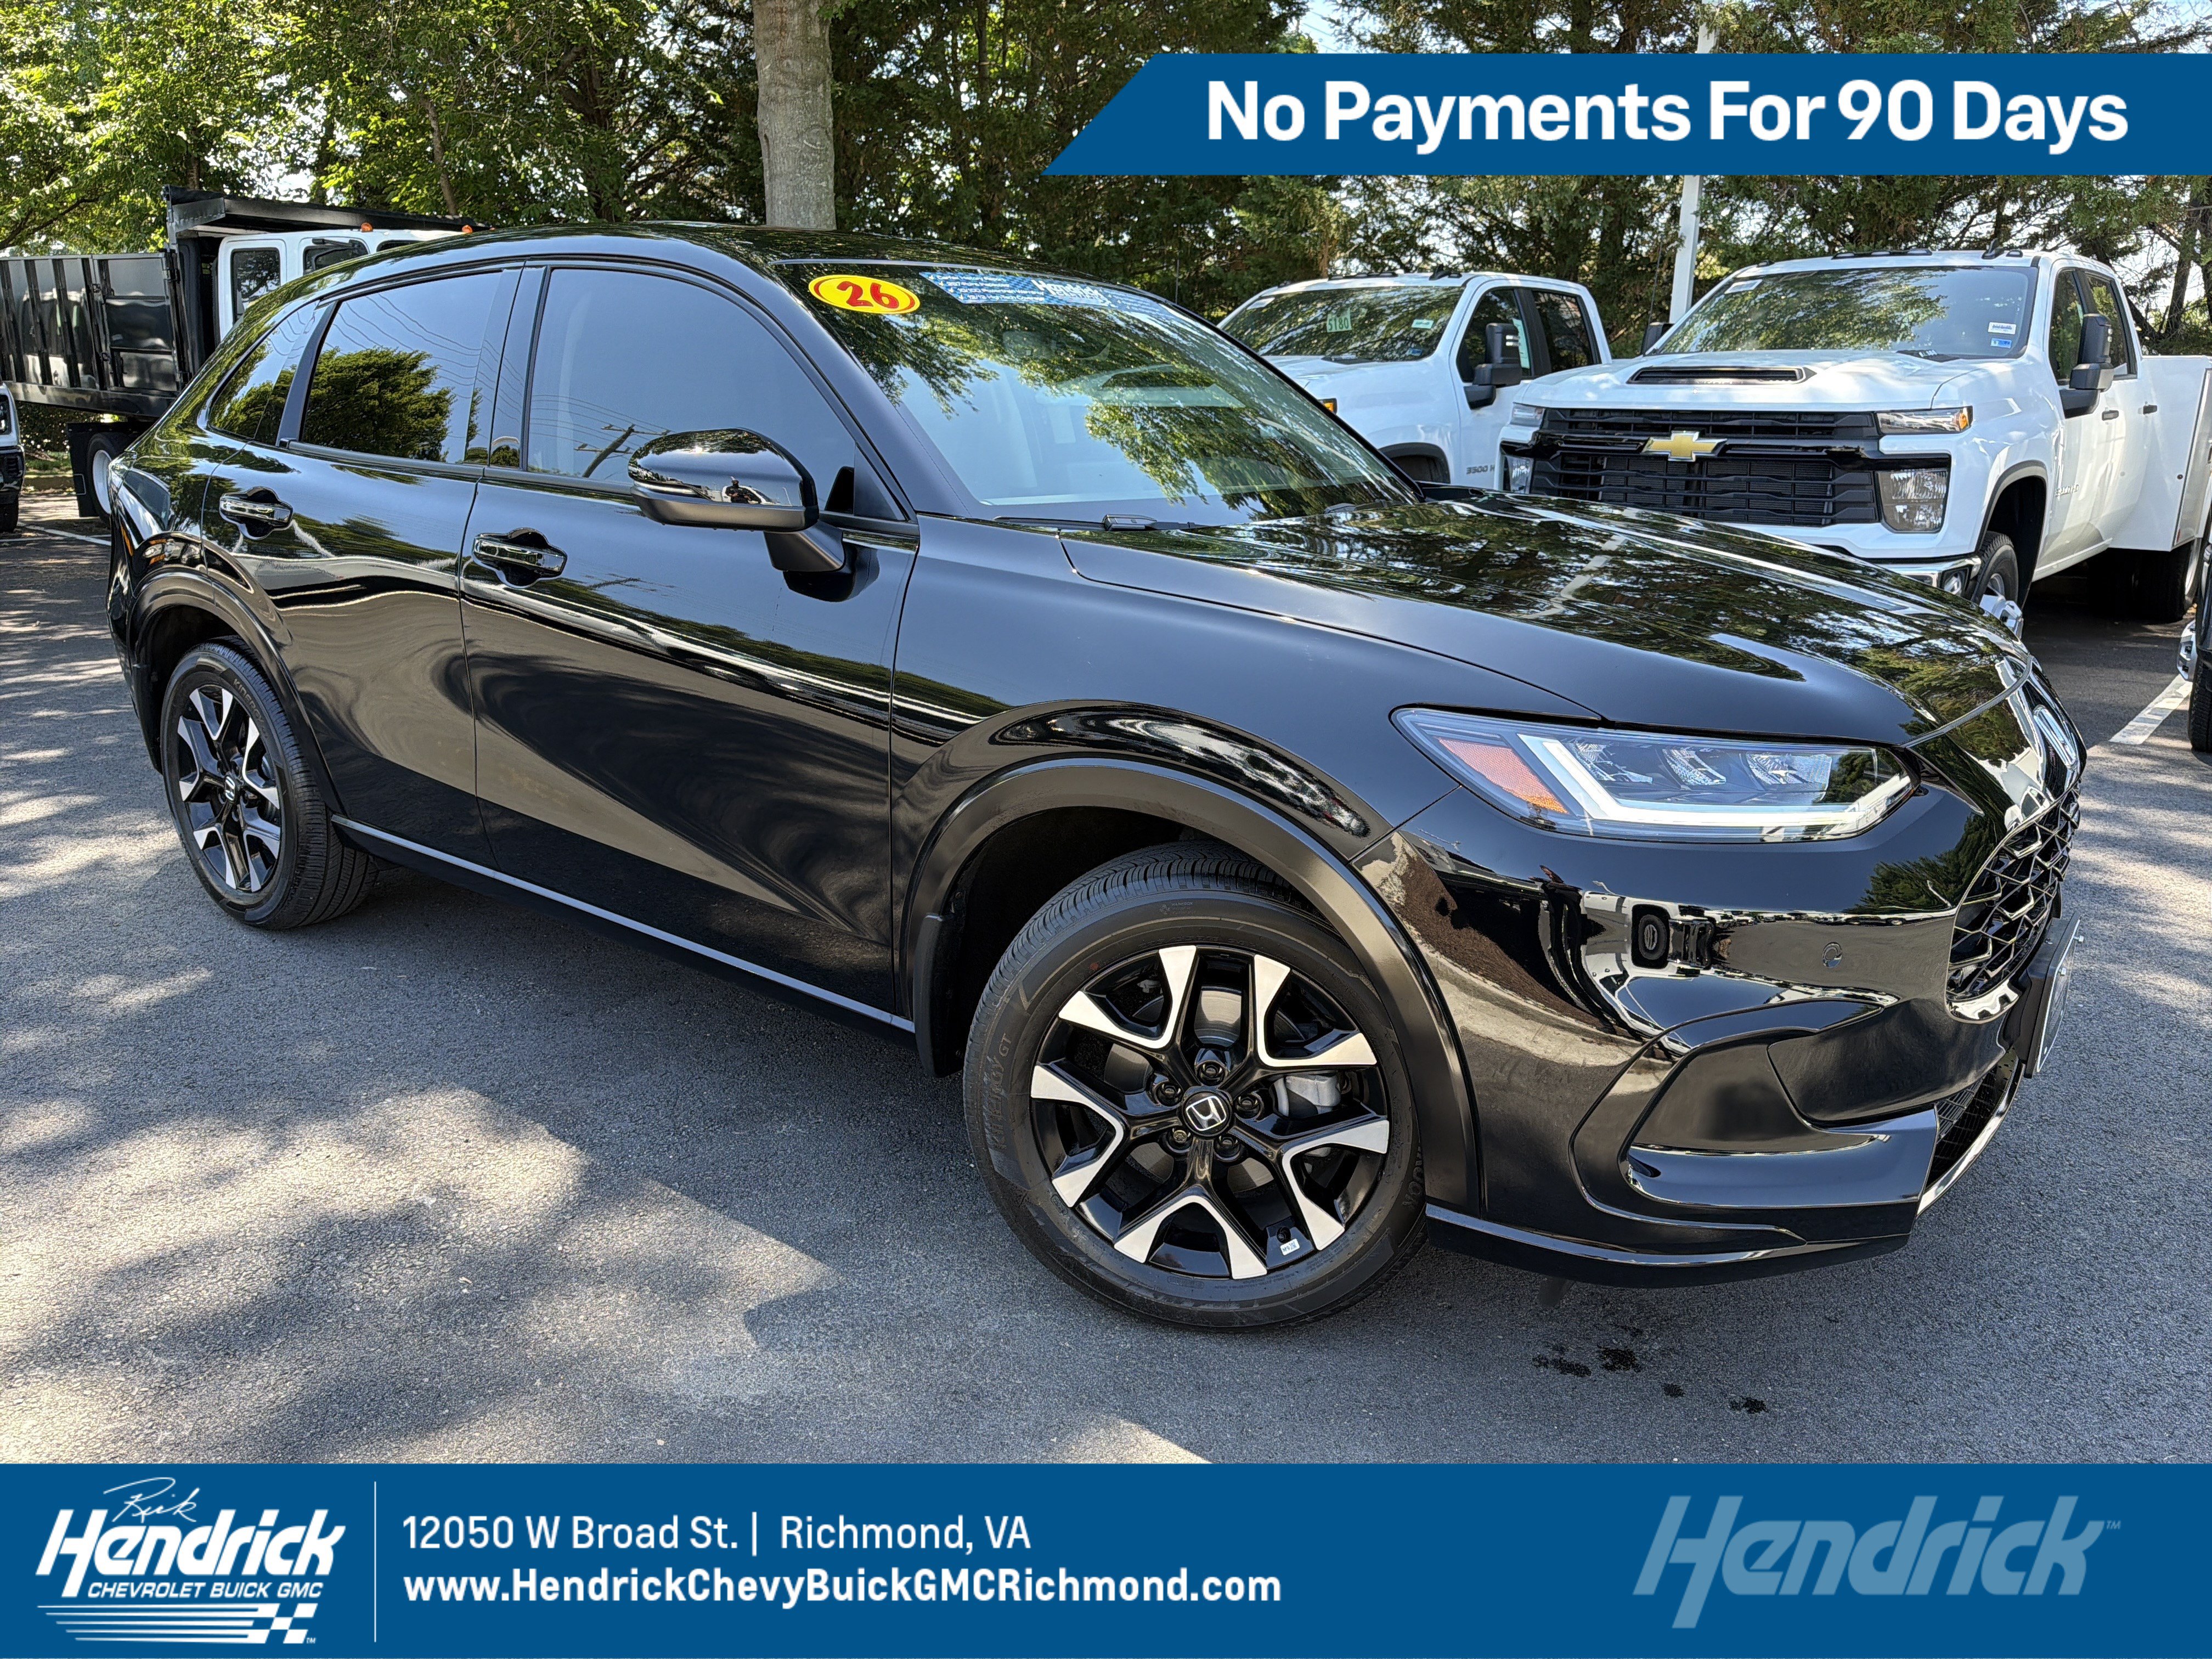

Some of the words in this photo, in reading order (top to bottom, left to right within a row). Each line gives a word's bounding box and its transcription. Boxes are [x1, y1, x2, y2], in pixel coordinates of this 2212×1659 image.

[837, 281, 900, 309] 26
[1328, 317, 1349, 331] 5180
[998, 1032, 1012, 1058] GT
